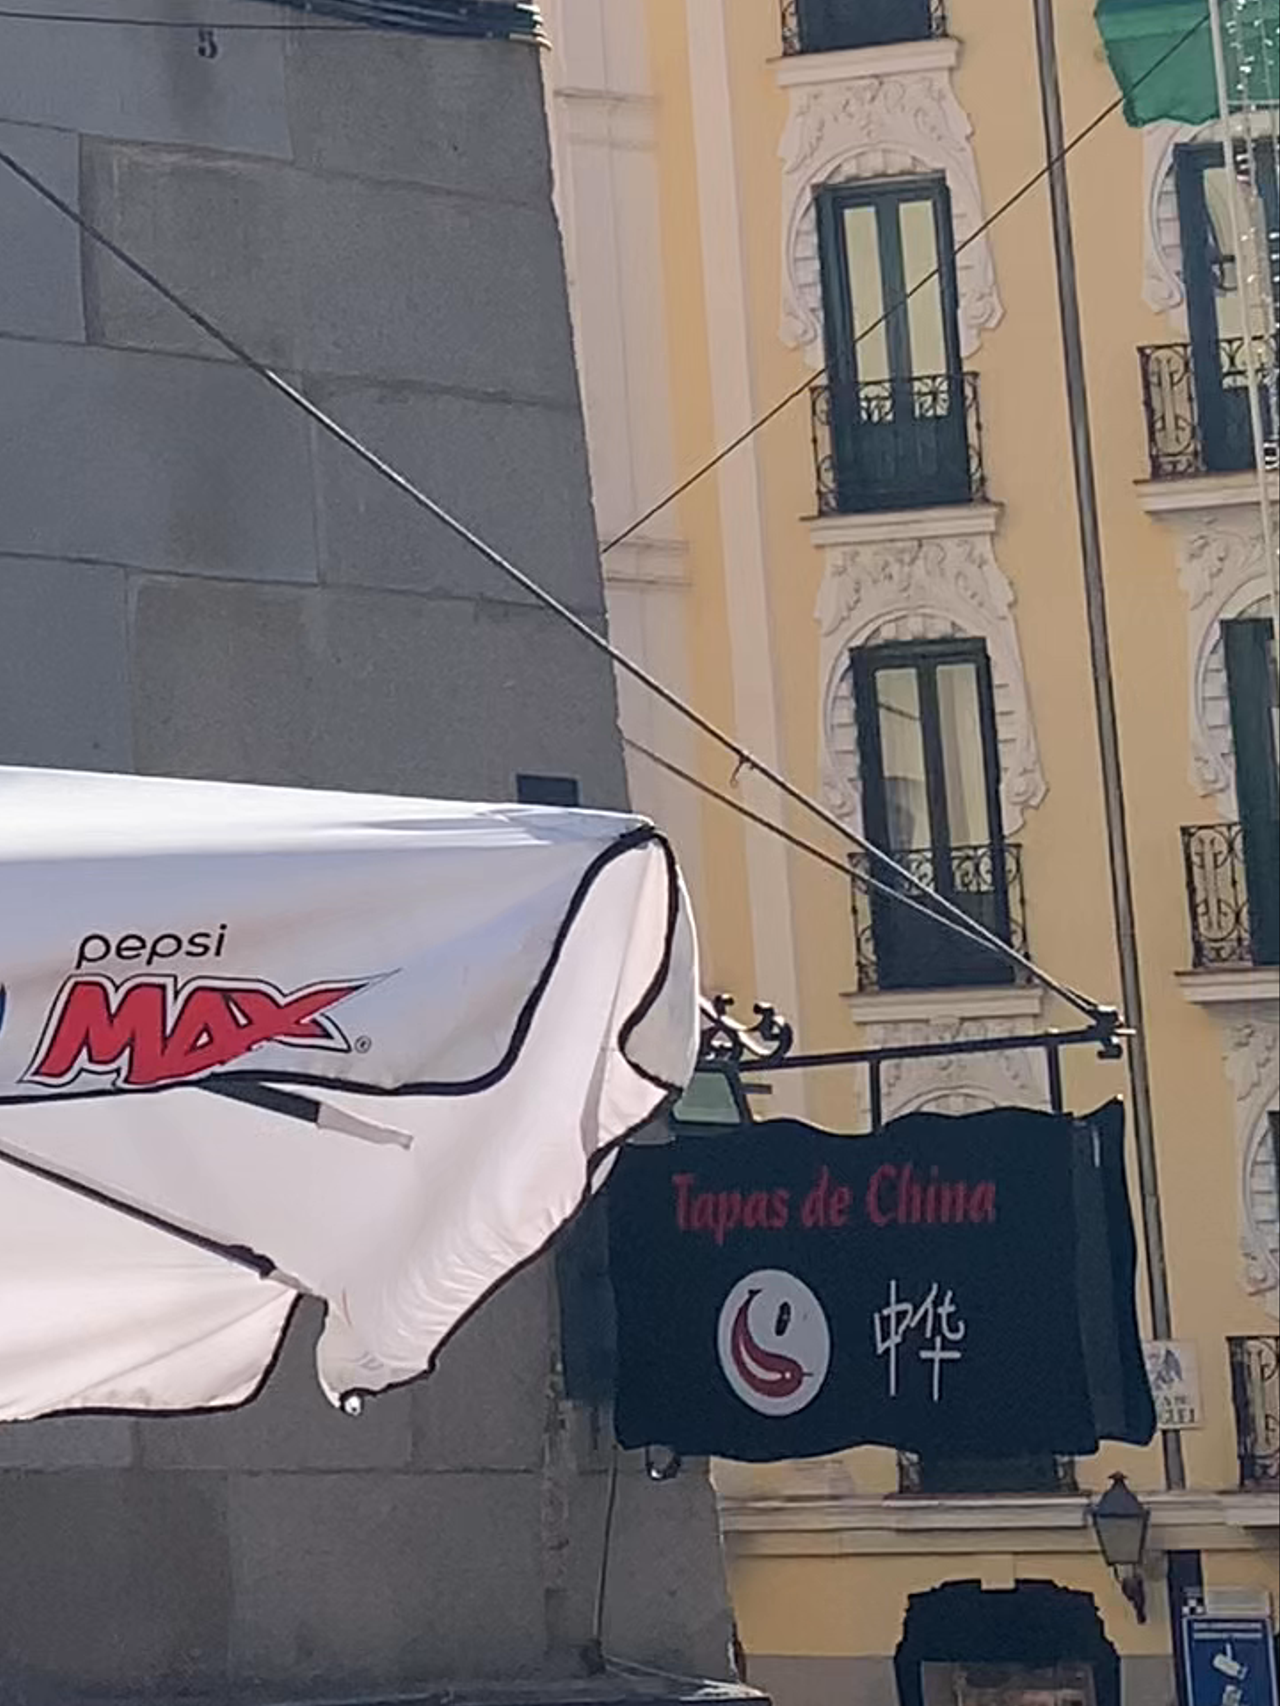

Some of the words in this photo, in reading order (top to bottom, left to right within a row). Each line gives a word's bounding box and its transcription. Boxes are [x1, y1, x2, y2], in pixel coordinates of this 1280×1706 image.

[75, 924, 227, 969] pepsi
[17, 970, 390, 1086] MAX
[672, 1172, 788, 1247] Tapas
[802, 1164, 853, 1227] de
[865, 1162, 996, 1227] China
